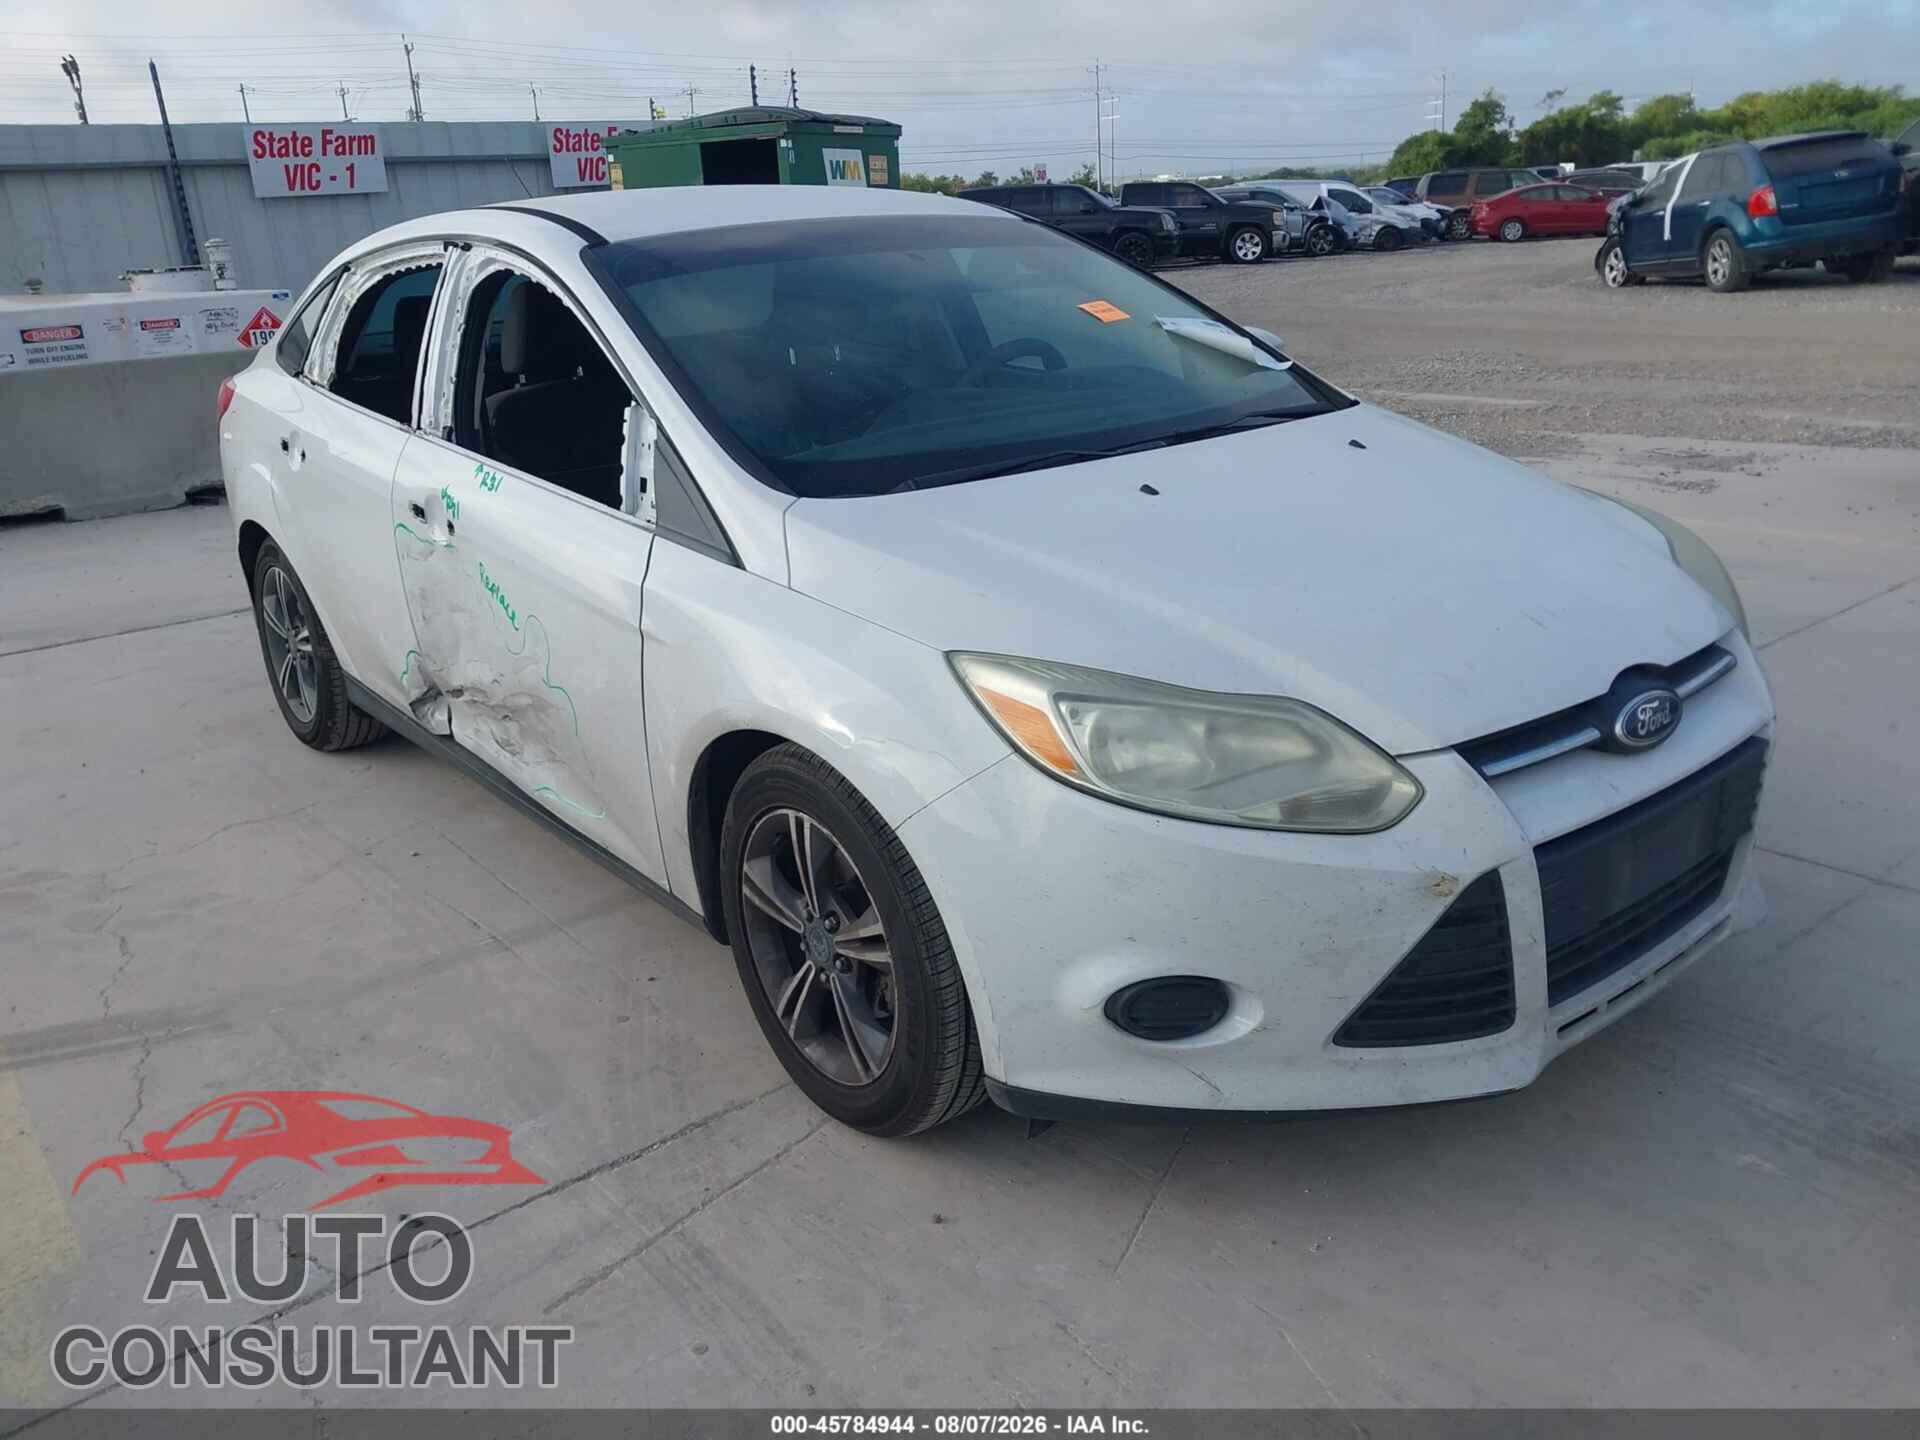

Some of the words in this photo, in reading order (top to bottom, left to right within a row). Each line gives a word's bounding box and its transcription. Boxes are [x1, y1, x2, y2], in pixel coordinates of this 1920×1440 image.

[253, 130, 314, 159] State
[321, 129, 376, 156] Farm
[553, 127, 600, 153] State
[284, 163, 321, 191] VIC
[345, 163, 356, 188] 1
[577, 156, 606, 181] VIC
[828, 159, 862, 180] WM
[33, 328, 72, 341] DANGER
[1638, 700, 1671, 735] Ford
